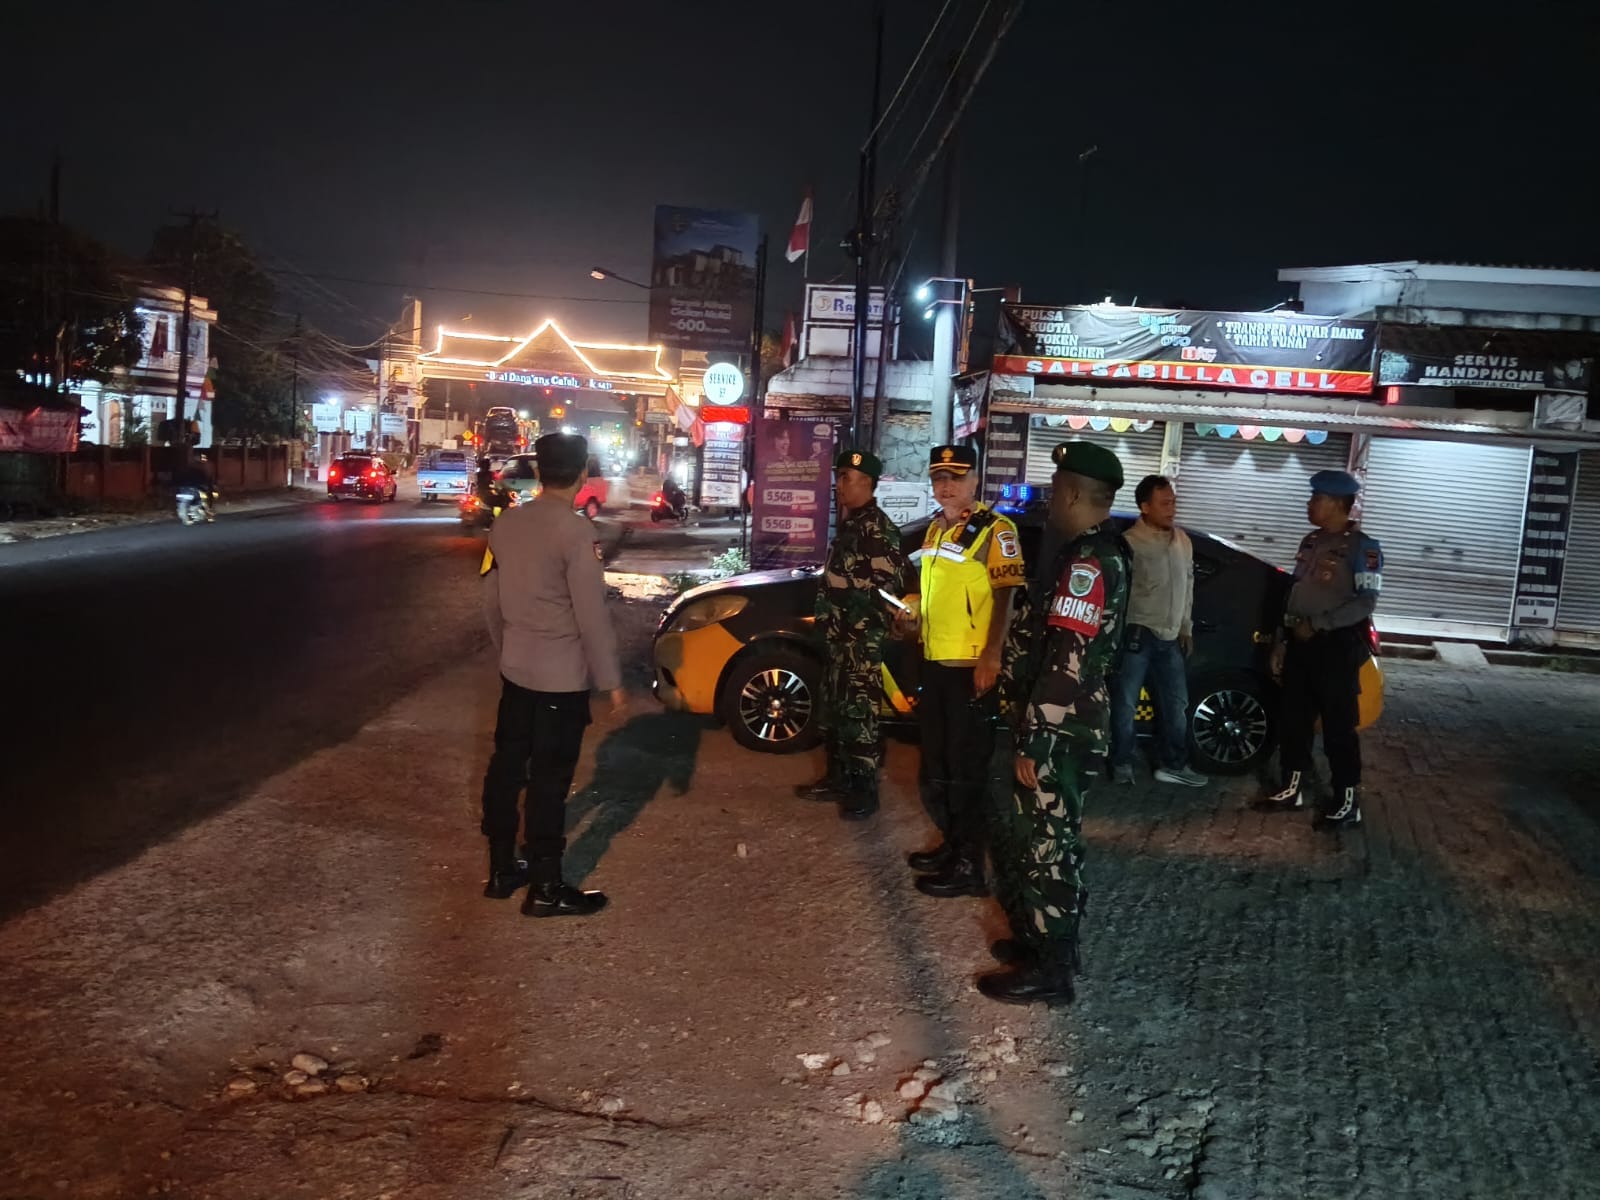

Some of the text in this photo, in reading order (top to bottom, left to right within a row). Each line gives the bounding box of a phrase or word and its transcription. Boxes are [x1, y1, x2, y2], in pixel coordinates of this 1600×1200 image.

[1022, 309, 1063, 321] PULSA
[1030, 322, 1071, 334] KUOTA
[1225, 321, 1364, 340] TRANSFER ANTAR BANK
[1036, 334, 1078, 346] TOKEN
[1233, 334, 1308, 349] TARIK TUNAI
[1453, 354, 1519, 368] SERVIS
[1026, 360, 1337, 390] SALSABILLA CELL
[1424, 366, 1545, 382] HANDPHONE
